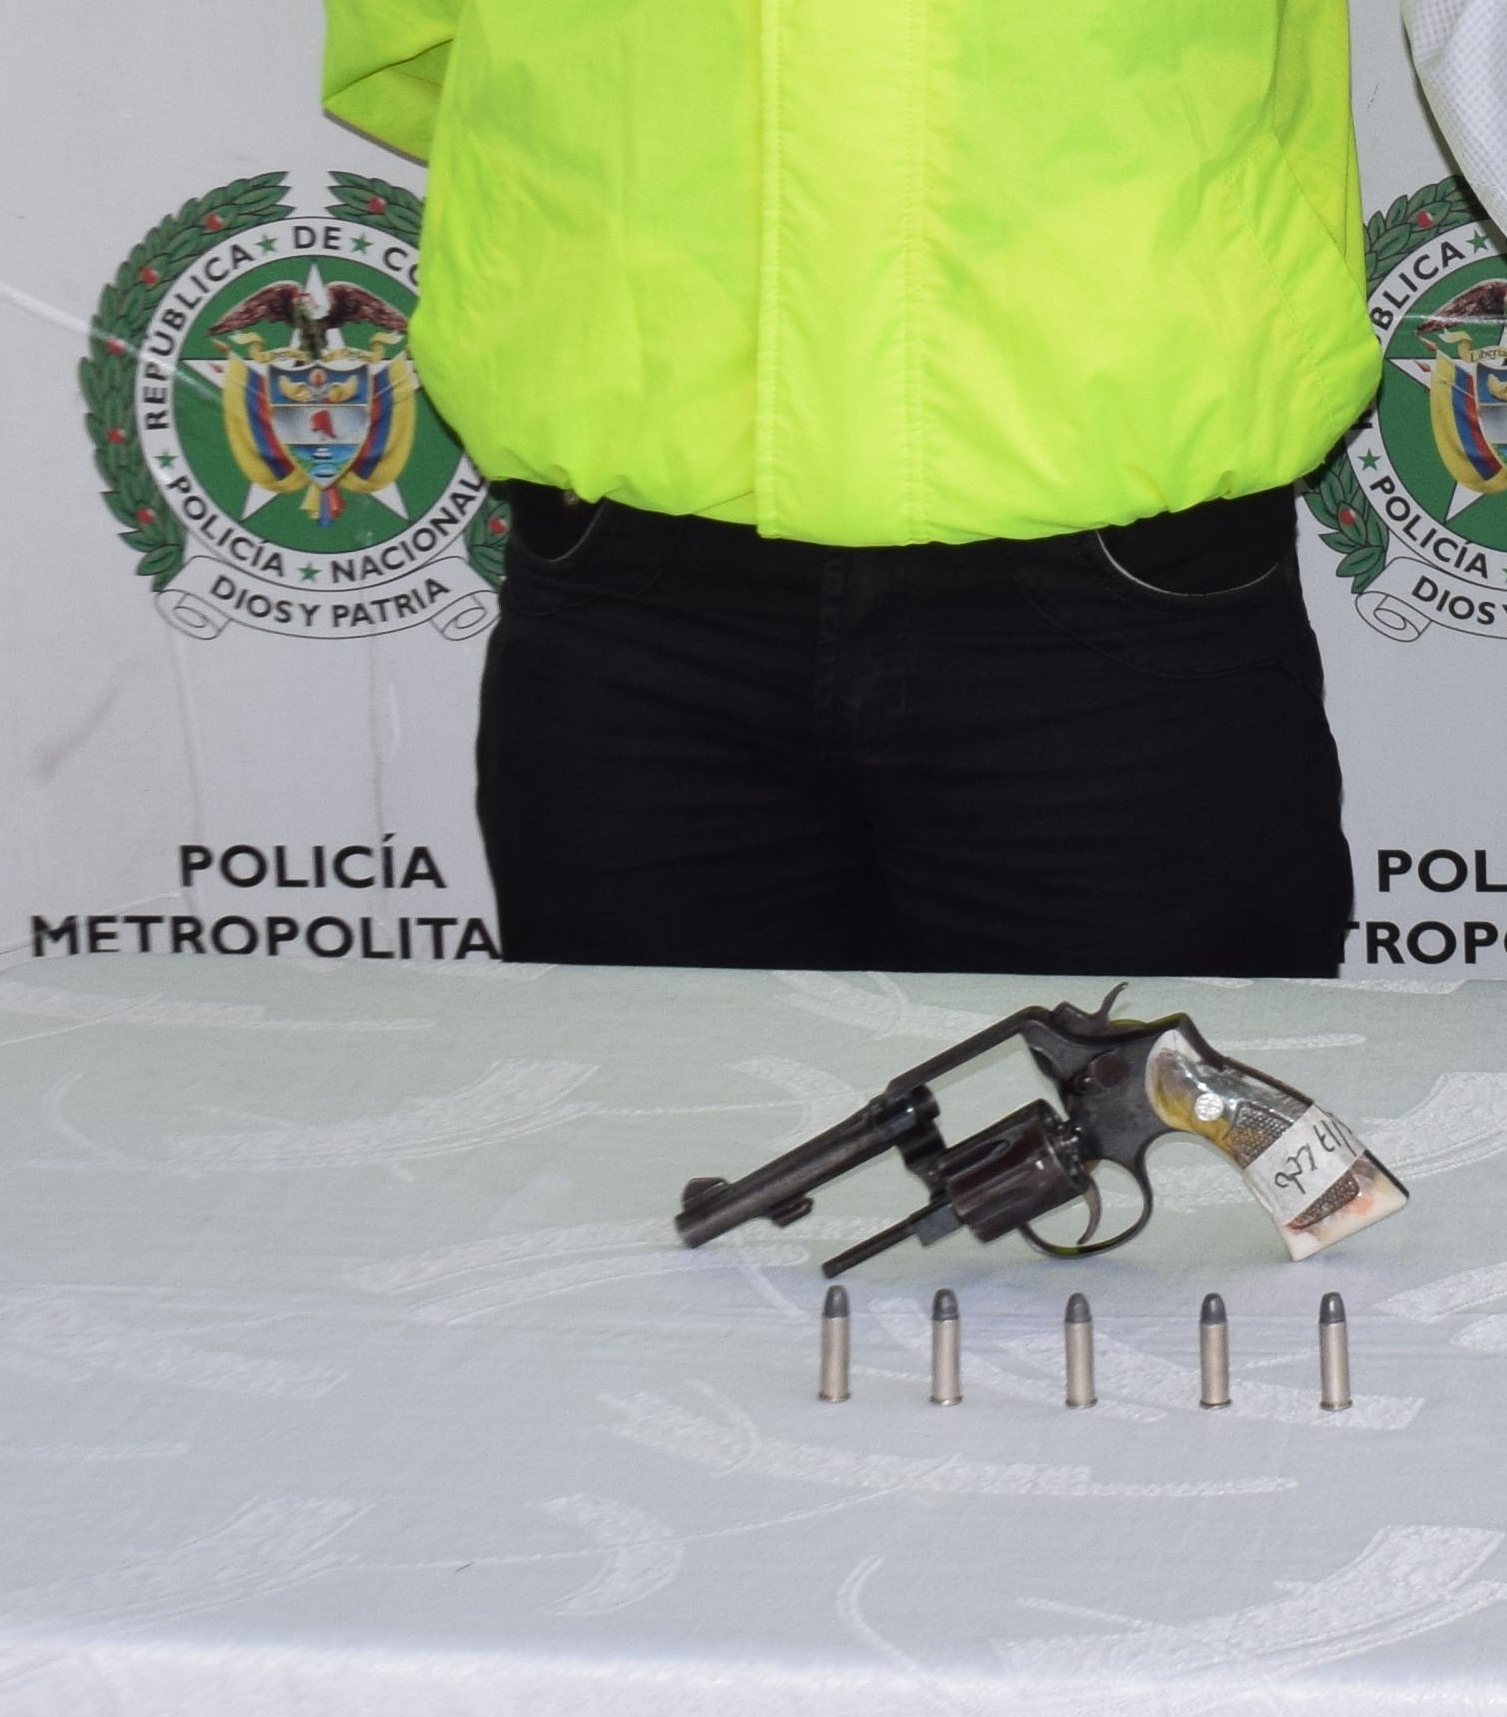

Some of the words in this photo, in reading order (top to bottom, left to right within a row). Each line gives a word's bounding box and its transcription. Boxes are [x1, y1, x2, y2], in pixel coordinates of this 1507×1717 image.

[145, 243, 254, 430] REPÚBLICA
[294, 227, 342, 250] DE
[168, 474, 285, 578] POLICÍA
[1369, 476, 1491, 580] POLICÍA
[209, 574, 294, 624] DIOS
[334, 578, 451, 628] PATRIA
[1411, 575, 1496, 625] DIOS
[180, 834, 447, 888] POLICÍA
